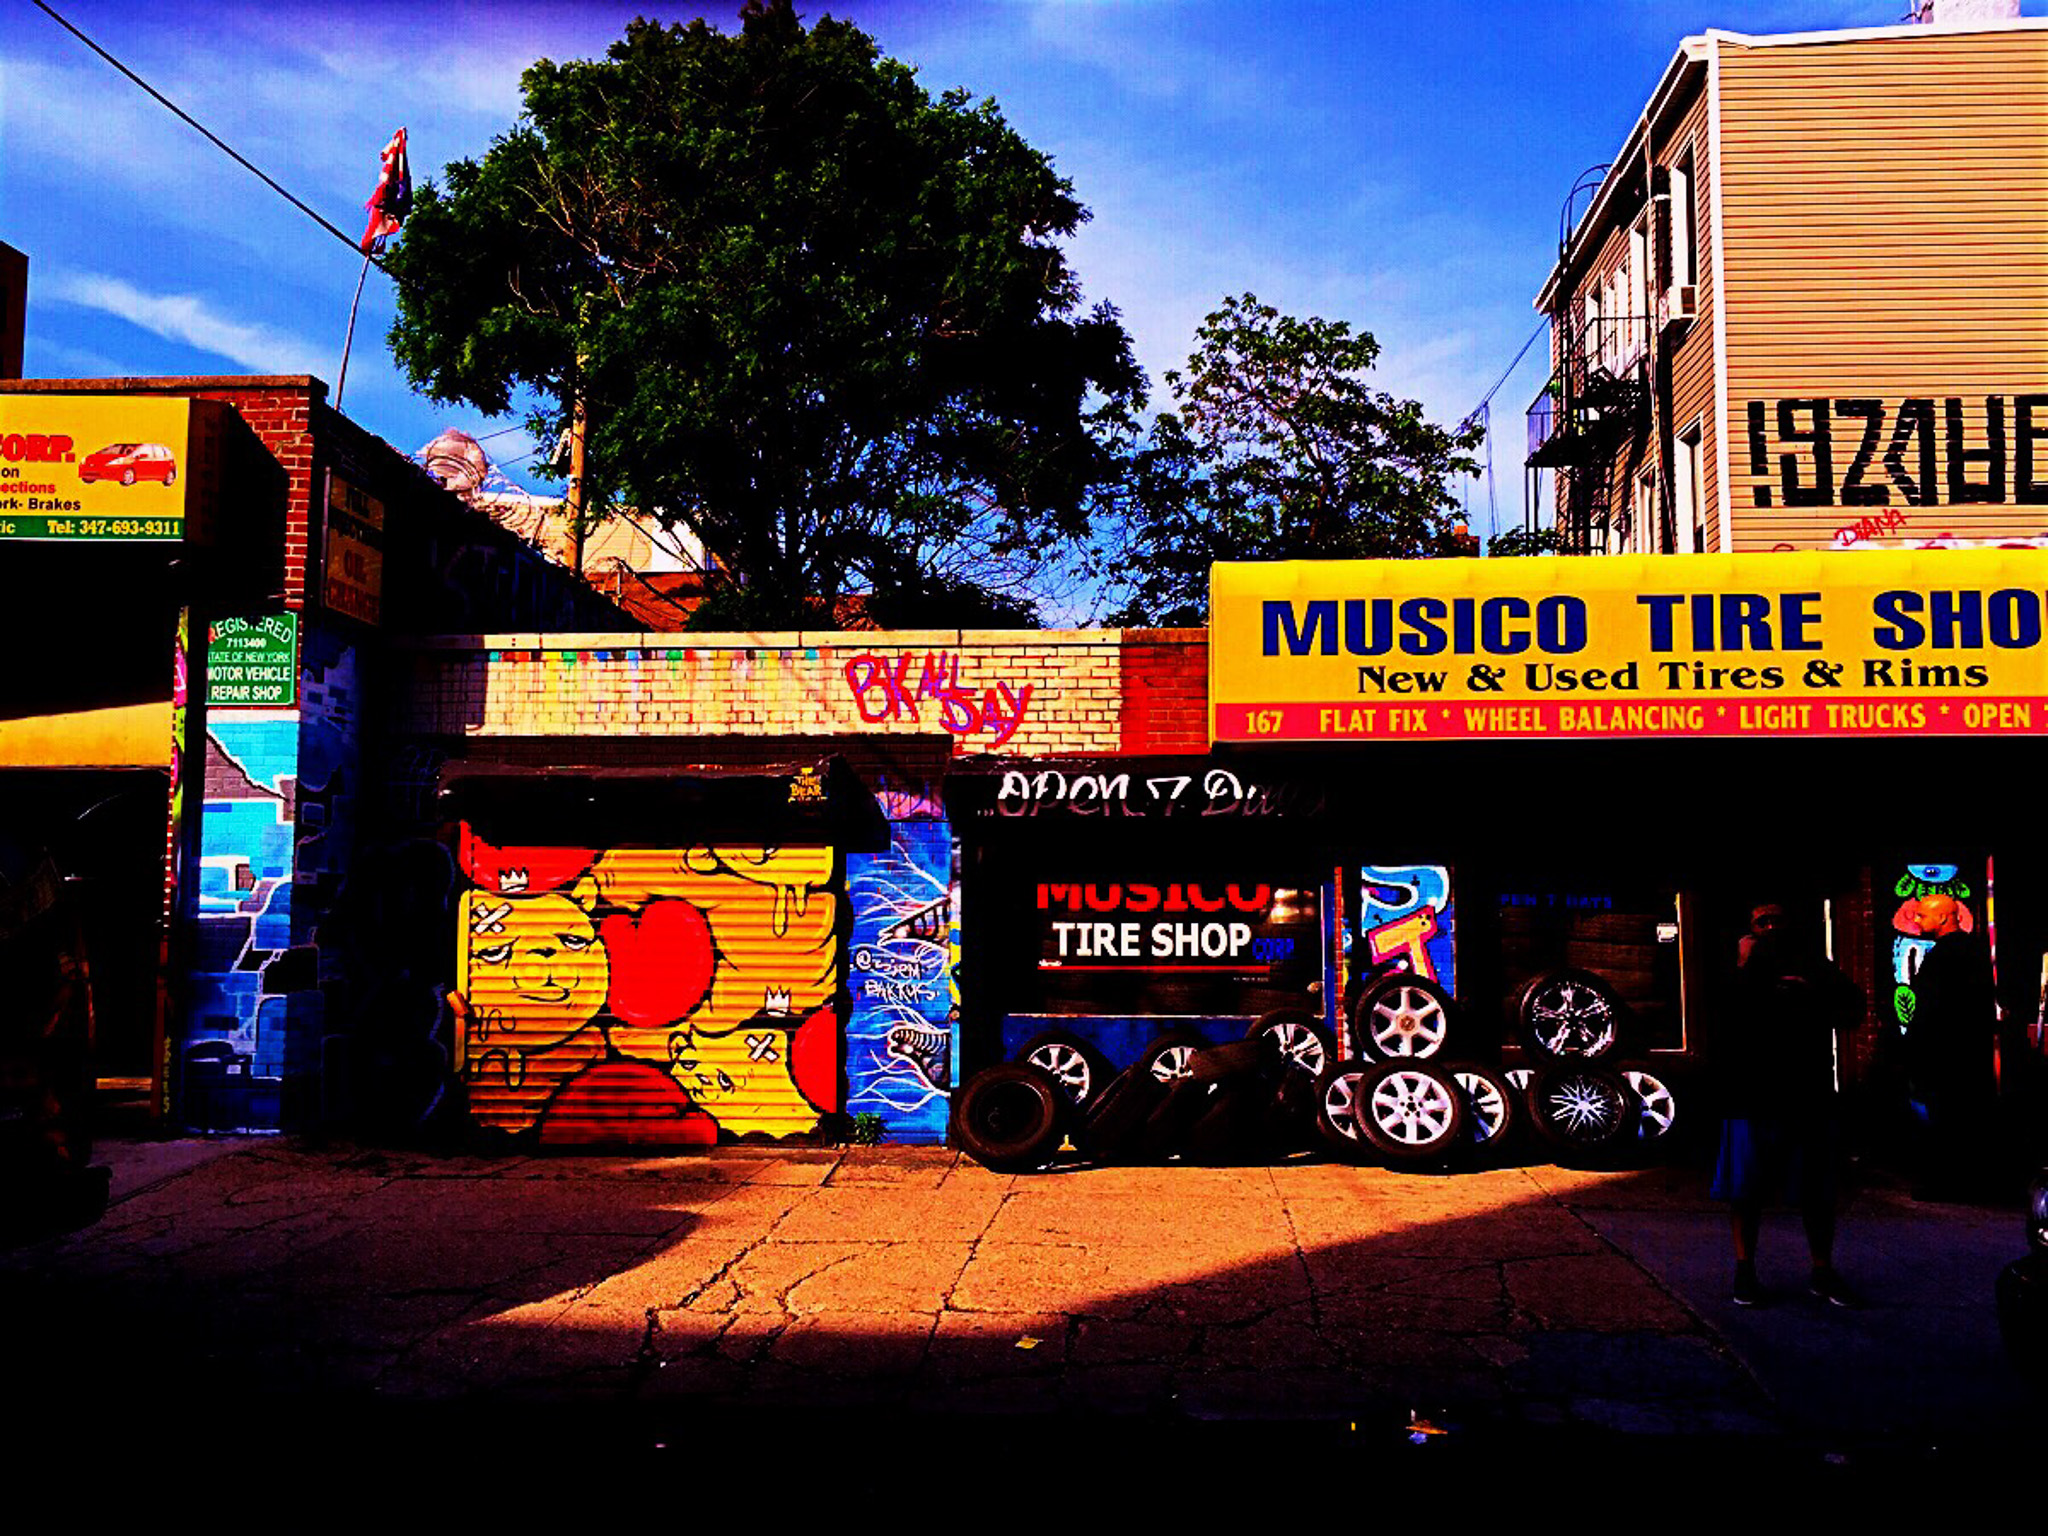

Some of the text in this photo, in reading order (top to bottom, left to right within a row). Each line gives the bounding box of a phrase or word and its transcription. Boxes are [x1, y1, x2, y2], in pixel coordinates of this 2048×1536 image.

[0, 433, 76, 463] ORP.
[28, 498, 81, 511] Brakes
[47, 520, 76, 534] Tel:
[79, 520, 179, 535] 347-693-9311
[208, 616, 293, 644] EGISERED
[1262, 587, 2048, 657] MUSICO TIRE SHO
[231, 651, 243, 662] OF
[245, 651, 264, 662] NEW
[266, 651, 291, 662] YORK
[245, 666, 291, 681] VEHICLE
[1358, 657, 1990, 695] New & Used Tires & Rims
[211, 685, 283, 700] REPAIR SHOP
[1245, 710, 1285, 734] 167
[1319, 708, 1377, 734] FLAT
[1388, 708, 1428, 733] FIX
[1464, 706, 1547, 732] WHEEL
[1559, 704, 1705, 732] BALANCING
[1738, 703, 1812, 730] LIGHT
[1825, 702, 1926, 729] TRUCKS
[1962, 702, 2032, 729] OPEN
[1052, 922, 1141, 957] TIRE
[1151, 922, 1252, 957] SHOP
